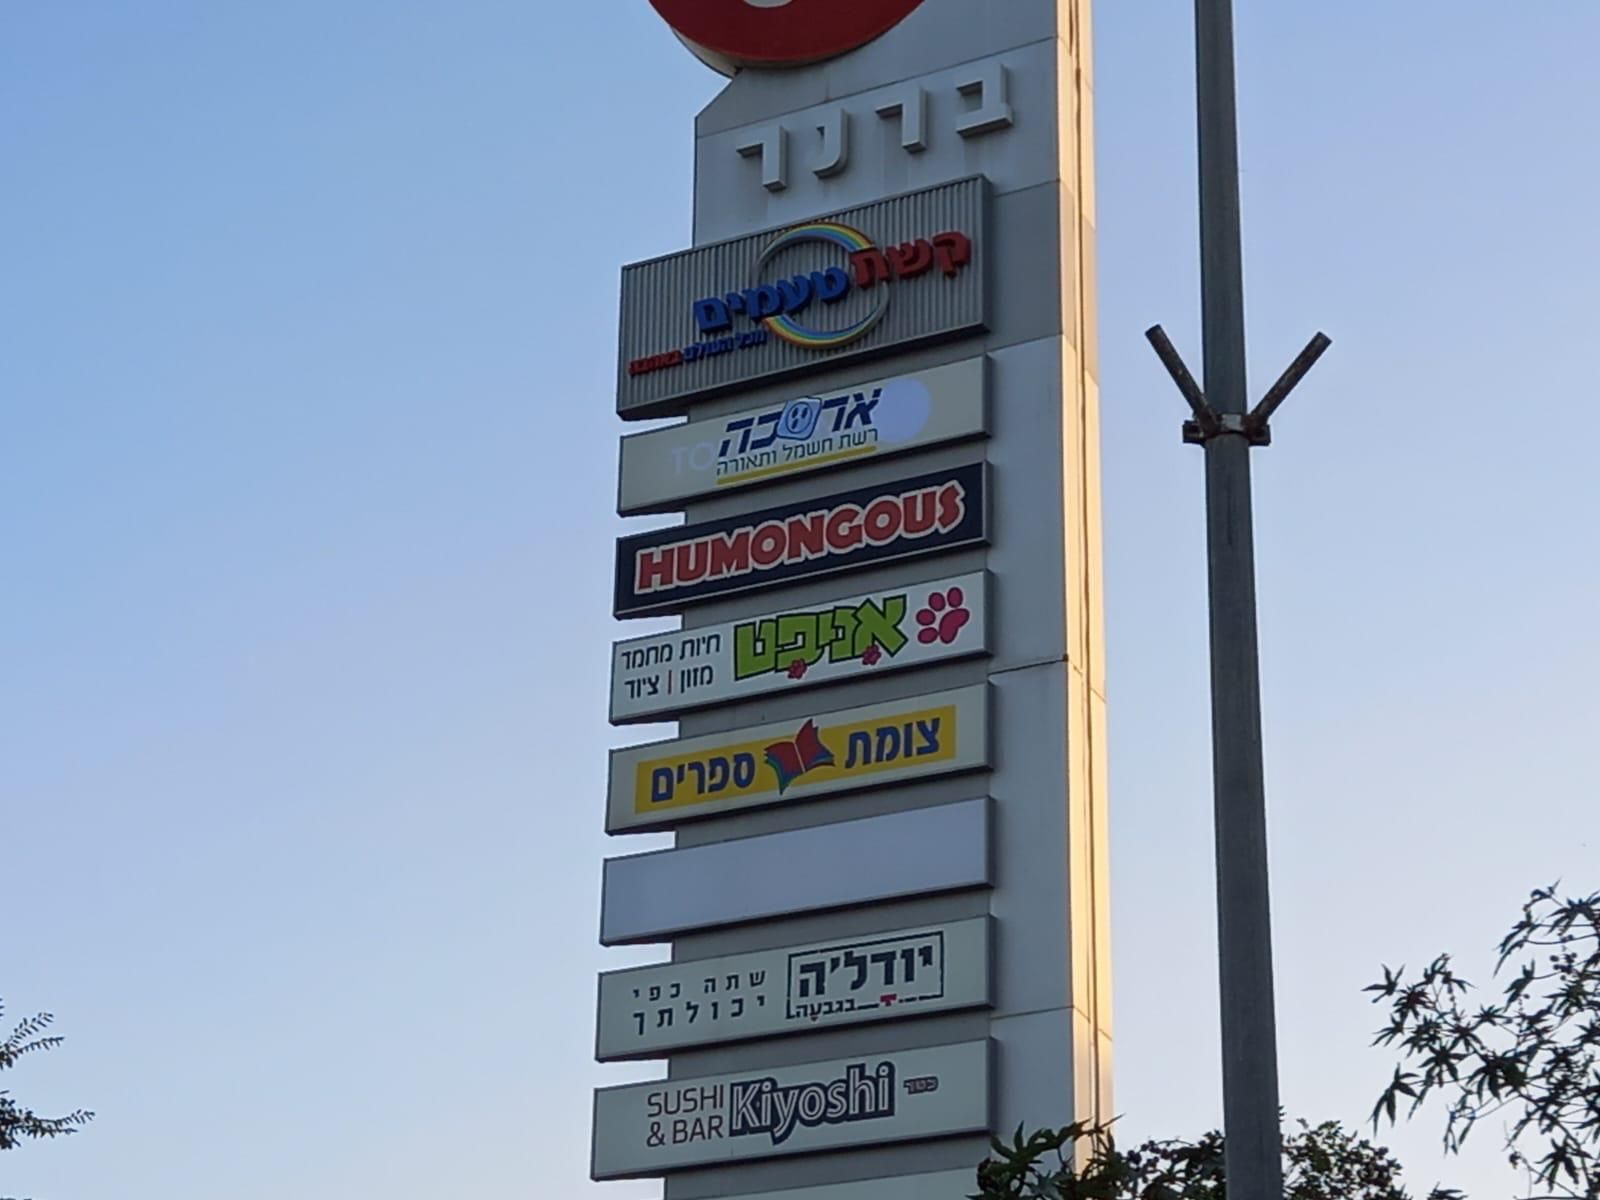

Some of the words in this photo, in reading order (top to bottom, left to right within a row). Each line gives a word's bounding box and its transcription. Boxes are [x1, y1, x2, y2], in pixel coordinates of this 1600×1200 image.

[736, 62, 1013, 192] ברנר
[851, 231, 971, 290] קשת
[693, 266, 849, 332] טעמים
[782, 440, 832, 462] חשמל
[837, 428, 879, 450] רשת
[716, 448, 777, 477] ותאורה
[634, 480, 966, 595] HUMONGOUS
[680, 633, 721, 660] חיות
[734, 594, 908, 681] אניפט
[621, 643, 673, 670] מחמד
[624, 675, 659, 699] ציוד
[680, 665, 714, 693] מזון
[845, 717, 940, 768] צומת
[651, 752, 755, 802] ספרים
[632, 982, 682, 1002] כפי
[703, 970, 767, 994] שתה
[633, 994, 766, 1036] יכולתך
[796, 998, 856, 1020] בגבעה
[648, 1085, 725, 1117] SUSHI
[729, 1061, 896, 1145] Kiyoshi
[647, 1121, 666, 1147] &
[672, 1115, 724, 1144] BAR
